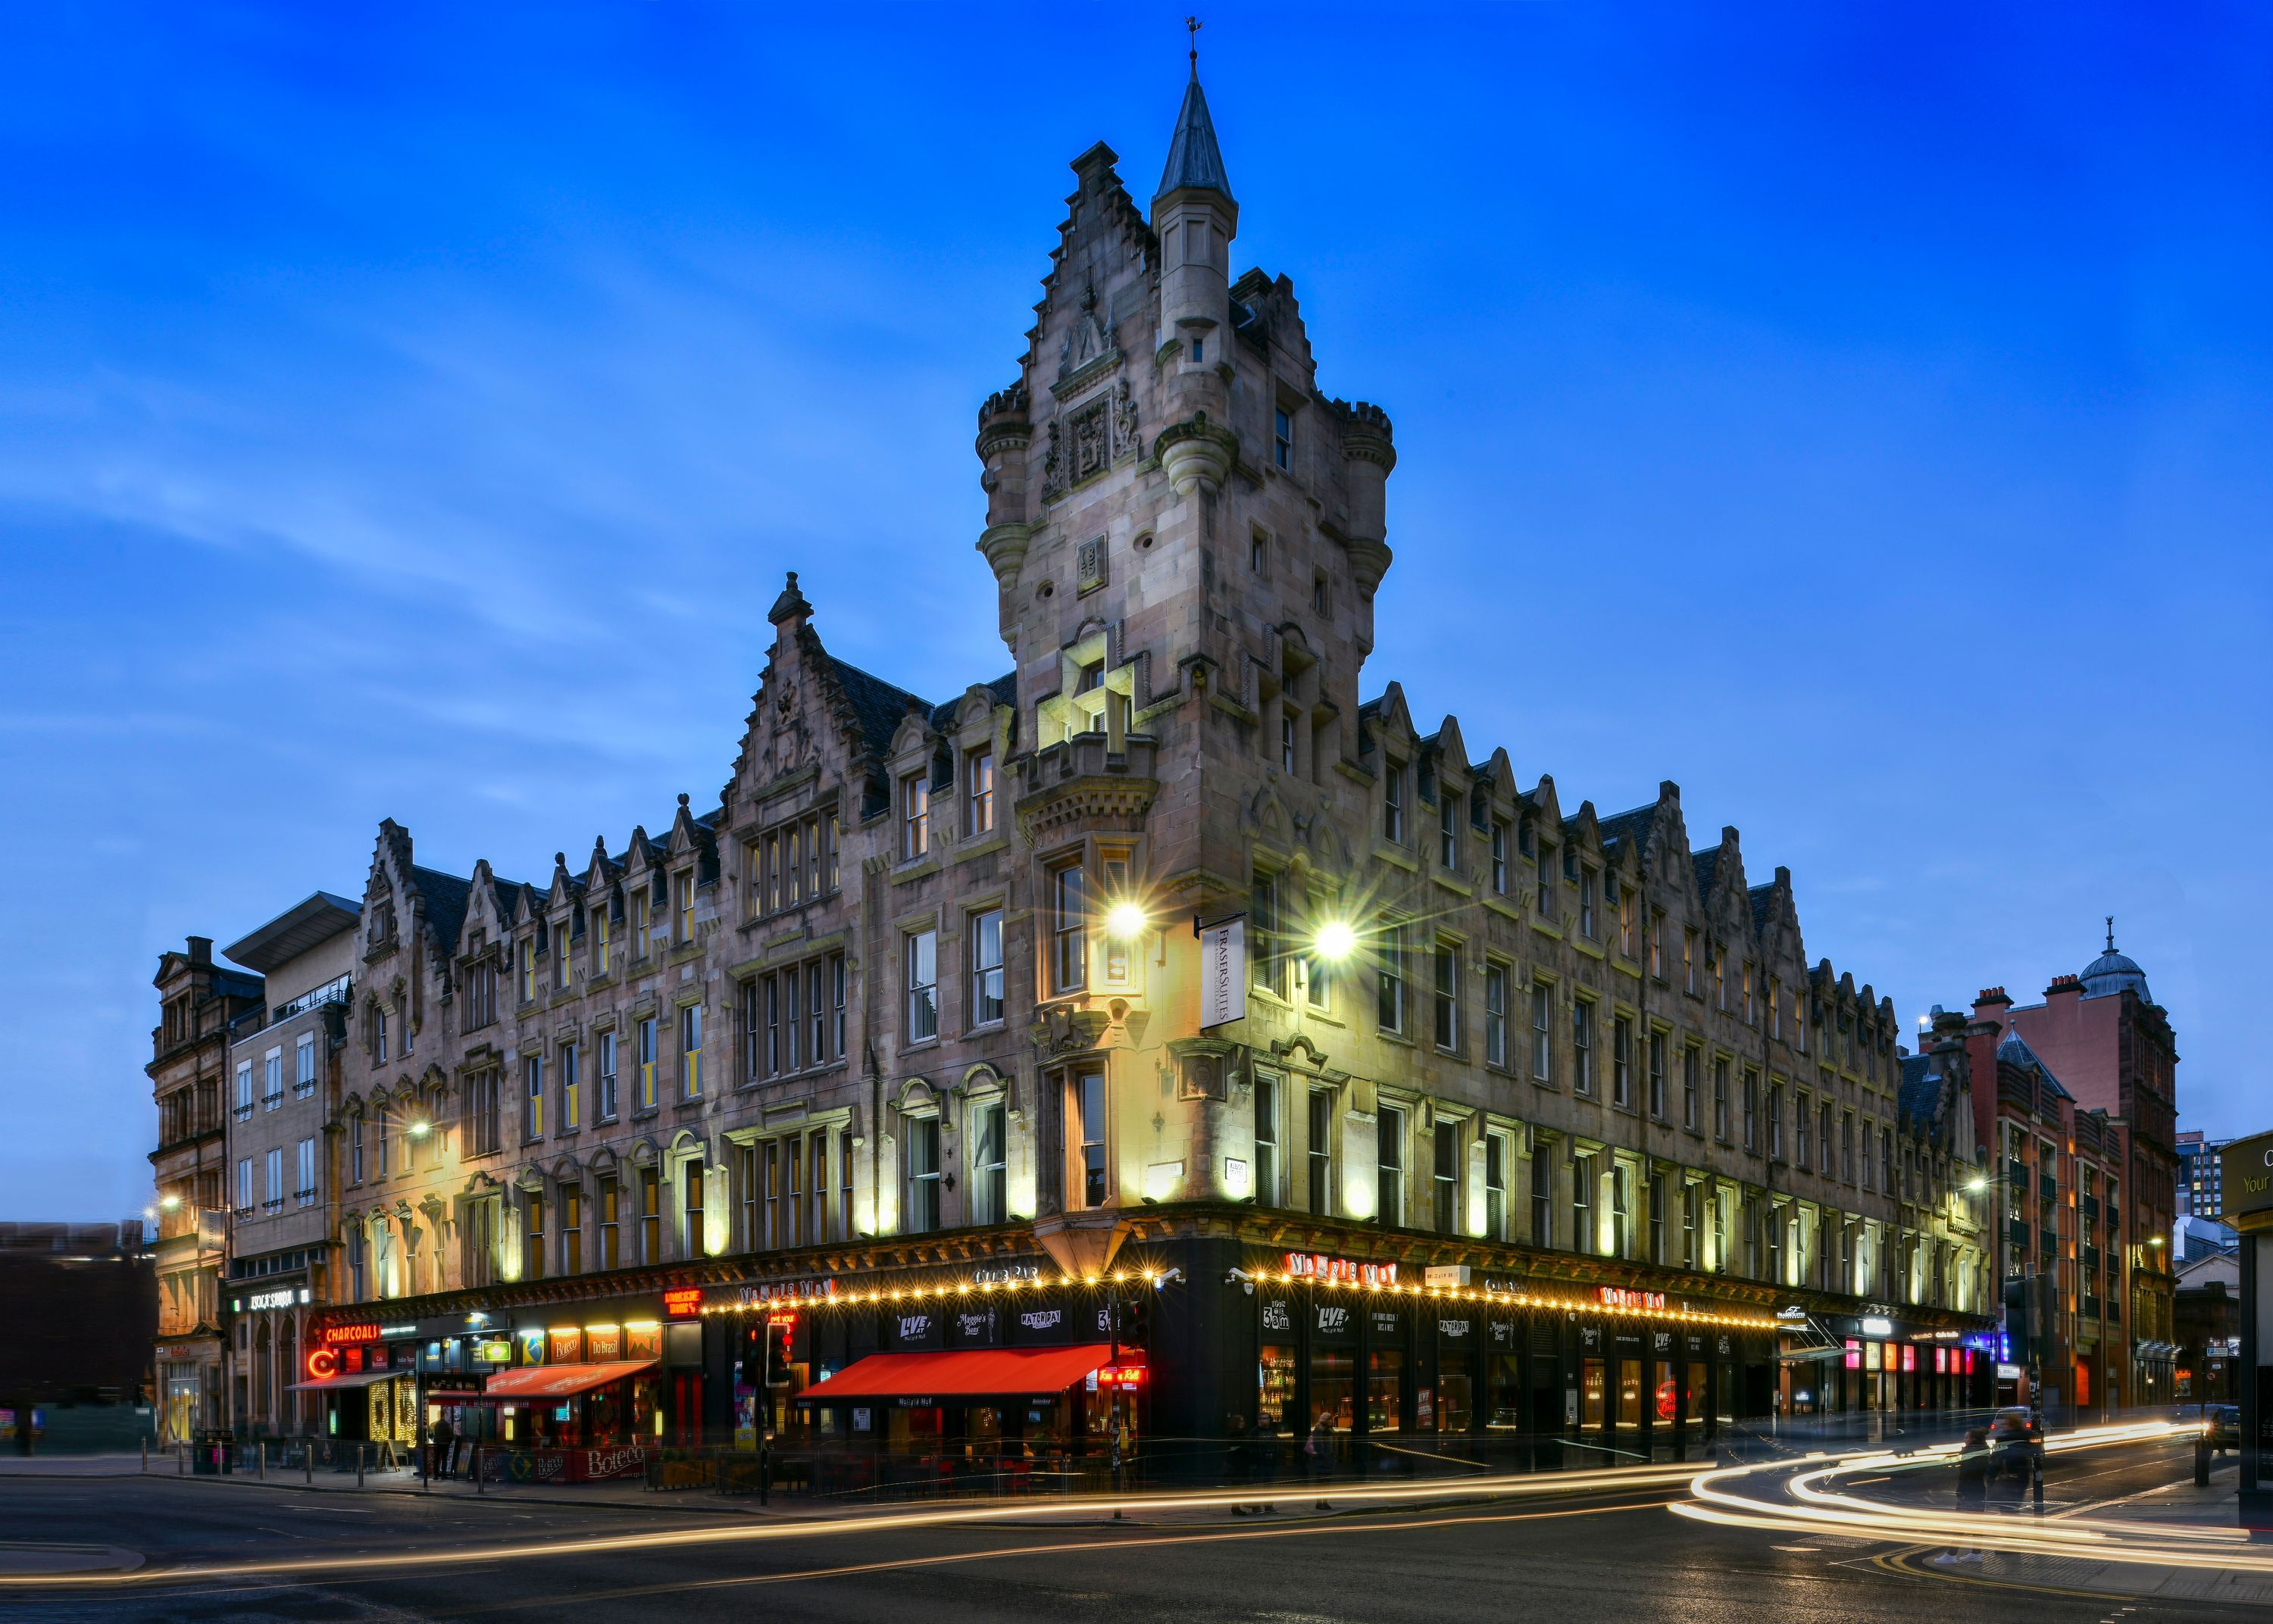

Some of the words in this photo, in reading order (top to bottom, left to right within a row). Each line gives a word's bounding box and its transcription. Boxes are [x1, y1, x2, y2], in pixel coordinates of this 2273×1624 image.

[1219, 929, 1229, 1020] FRASERSUITES
[2243, 1176, 2270, 1193] Your
[1364, 1263, 1397, 1285] May
[900, 1316, 928, 1338] LIVE
[957, 1313, 986, 1327] Maggie's
[1263, 1307, 1290, 1330] 3am
[1318, 1307, 1346, 1328] LIVE
[327, 1325, 377, 1342] CHARCOALS
[965, 1326, 980, 1335] Buns
[556, 1338, 577, 1357] Boteco
[592, 1341, 601, 1354] Do
[602, 1340, 617, 1354] Brasil
[587, 1447, 643, 1476] Boteco
